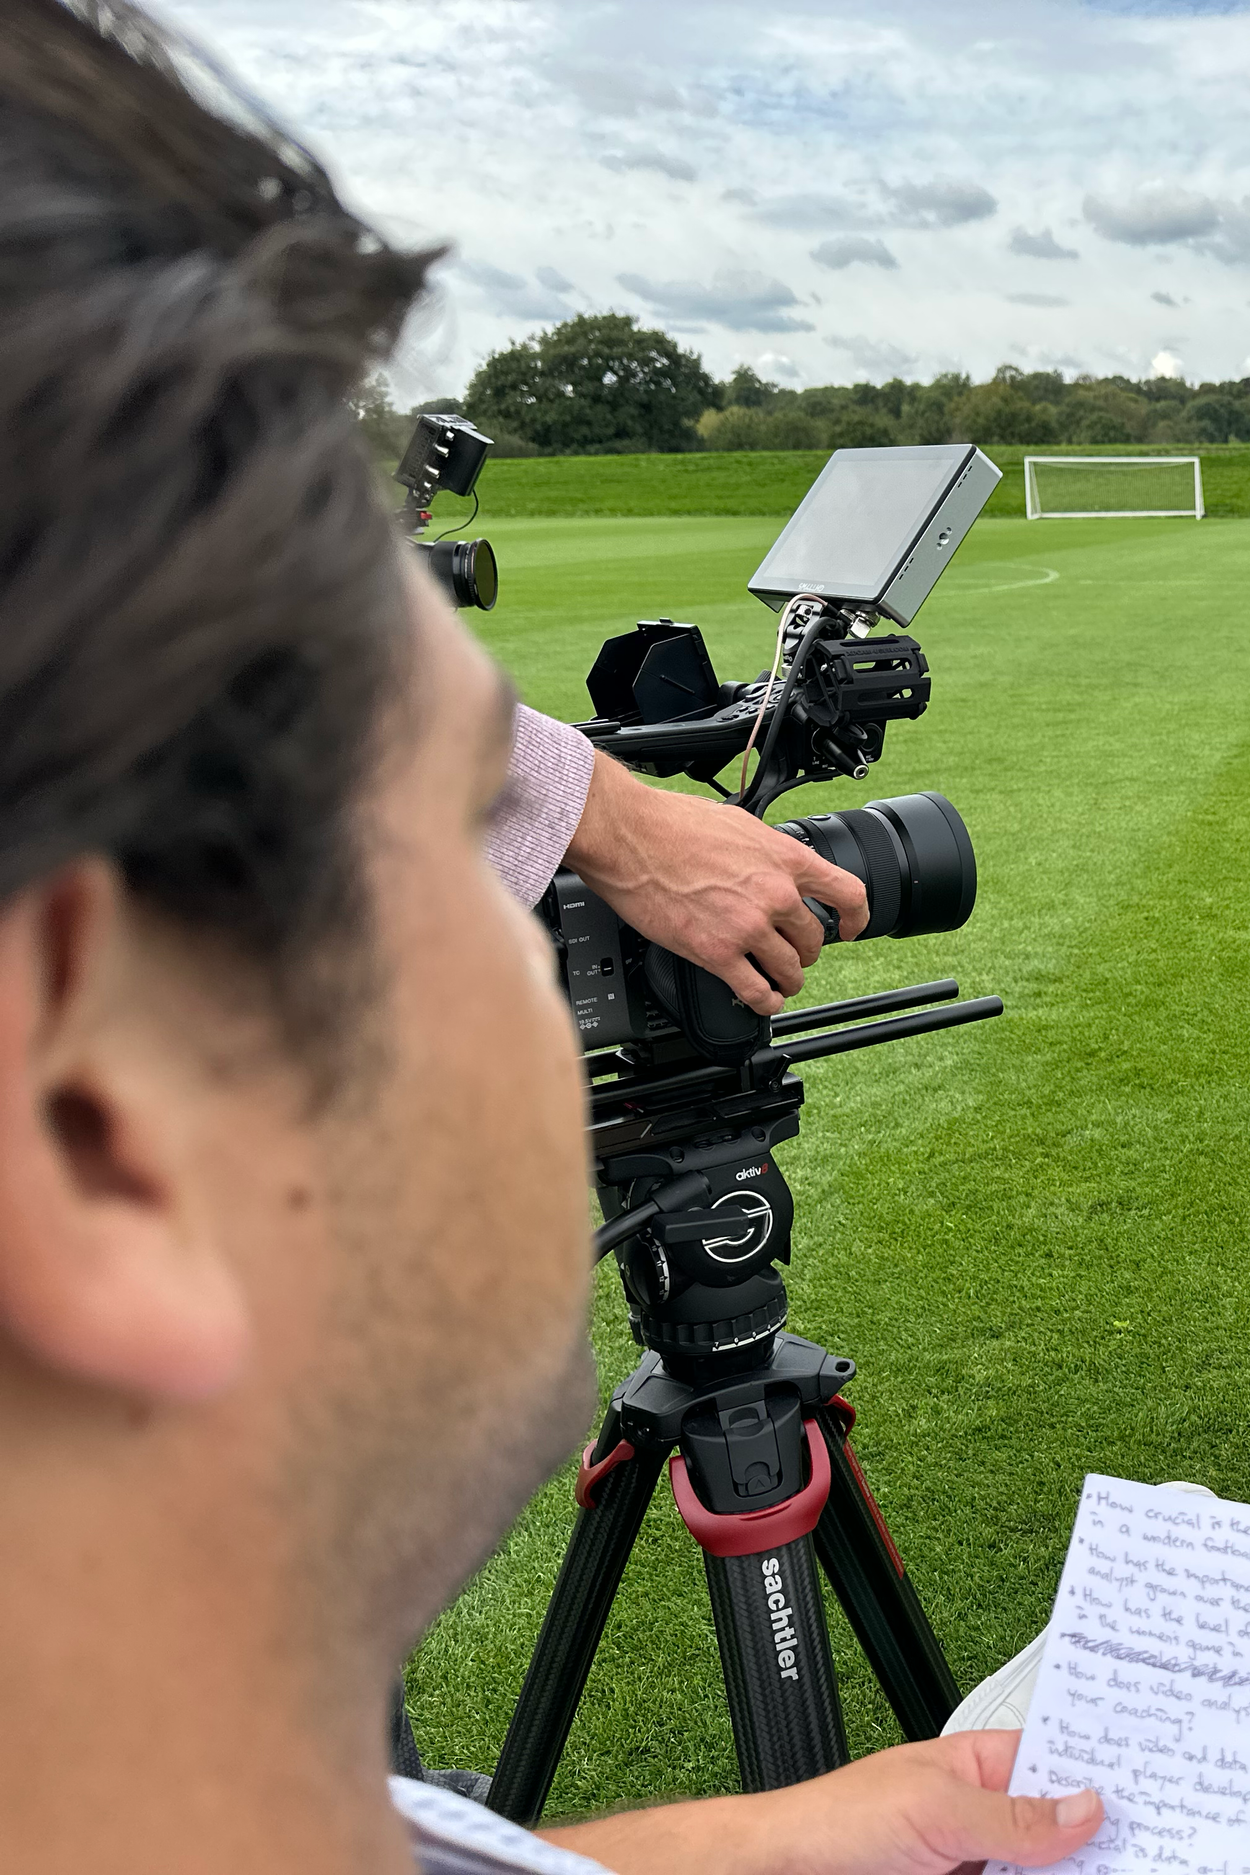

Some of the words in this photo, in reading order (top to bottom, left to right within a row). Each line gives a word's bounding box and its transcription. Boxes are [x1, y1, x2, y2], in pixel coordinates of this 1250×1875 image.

[563, 901, 585, 910] HDMI
[578, 935, 590, 943] OUT
[587, 969, 598, 977] OUT
[575, 997, 598, 1006] REMOTE
[735, 1162, 769, 1182] aktiv8
[1097, 1491, 1133, 1513] How
[1145, 1509, 1201, 1530] crucial
[1209, 1515, 1223, 1530] is
[1090, 1511, 1104, 1528] in
[1118, 1523, 1131, 1537] a
[1142, 1530, 1195, 1551] modern
[1088, 1542, 1116, 1563] How
[1124, 1551, 1149, 1573] has
[1154, 1558, 1178, 1576] the
[1088, 1566, 1138, 1592] analyst
[1145, 1581, 1187, 1601] grown
[1194, 1594, 1224, 1607] over
[762, 1557, 800, 1681] sachtler
[1083, 1586, 1113, 1608] How
[1123, 1598, 1151, 1619] has
[1161, 1606, 1184, 1626] the
[1196, 1612, 1230, 1636] level
[1075, 1605, 1089, 1620] in
[1098, 1612, 1120, 1632] the
[1186, 1639, 1224, 1660] game
[1227, 1641, 1243, 1658] in
[1067, 1660, 1096, 1681] How
[1106, 1669, 1141, 1693] does
[1150, 1679, 1192, 1701] video
[1067, 1688, 1105, 1707] your
[1058, 1718, 1091, 1740] How
[1098, 1727, 1130, 1748] does
[1138, 1736, 1176, 1757] video
[1183, 1745, 1208, 1764] and
[1214, 1747, 1248, 1774] data
[1047, 1740, 1121, 1771] individual
[1131, 1761, 1185, 1792] player
[1112, 1783, 1138, 1805] the
[1138, 1791, 1221, 1823] importance
[1227, 1810, 1247, 1827] of
[1129, 1820, 1197, 1847] process?
[1152, 1845, 1189, 1867] data
